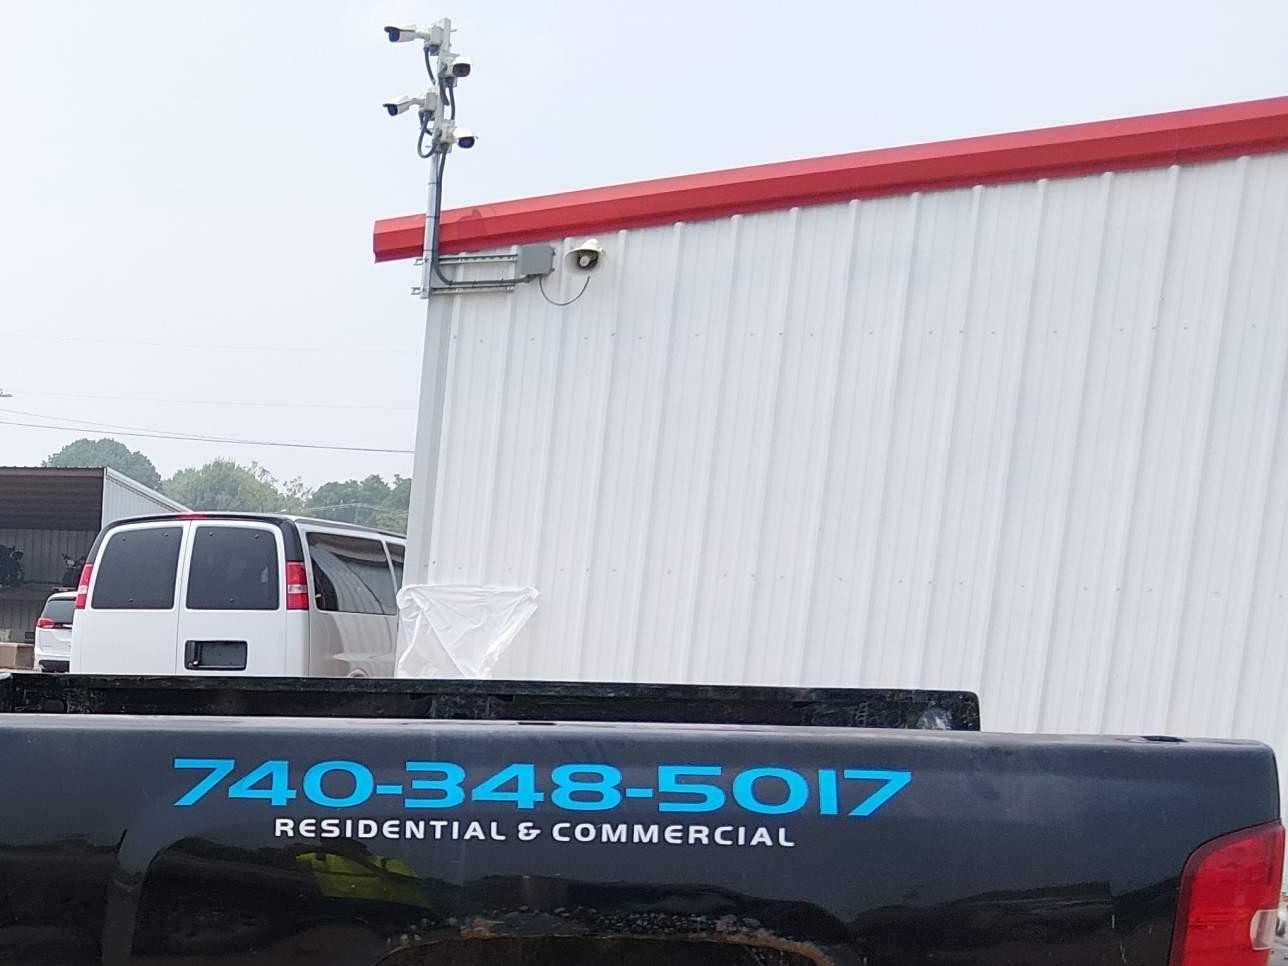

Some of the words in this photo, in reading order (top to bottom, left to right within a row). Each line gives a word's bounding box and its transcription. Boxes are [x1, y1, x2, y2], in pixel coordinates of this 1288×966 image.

[173, 758, 914, 817] 740-348-5017
[274, 818, 507, 842] RESIDENTIAL
[517, 821, 542, 842] &
[552, 822, 796, 847] COMMERCIAL
